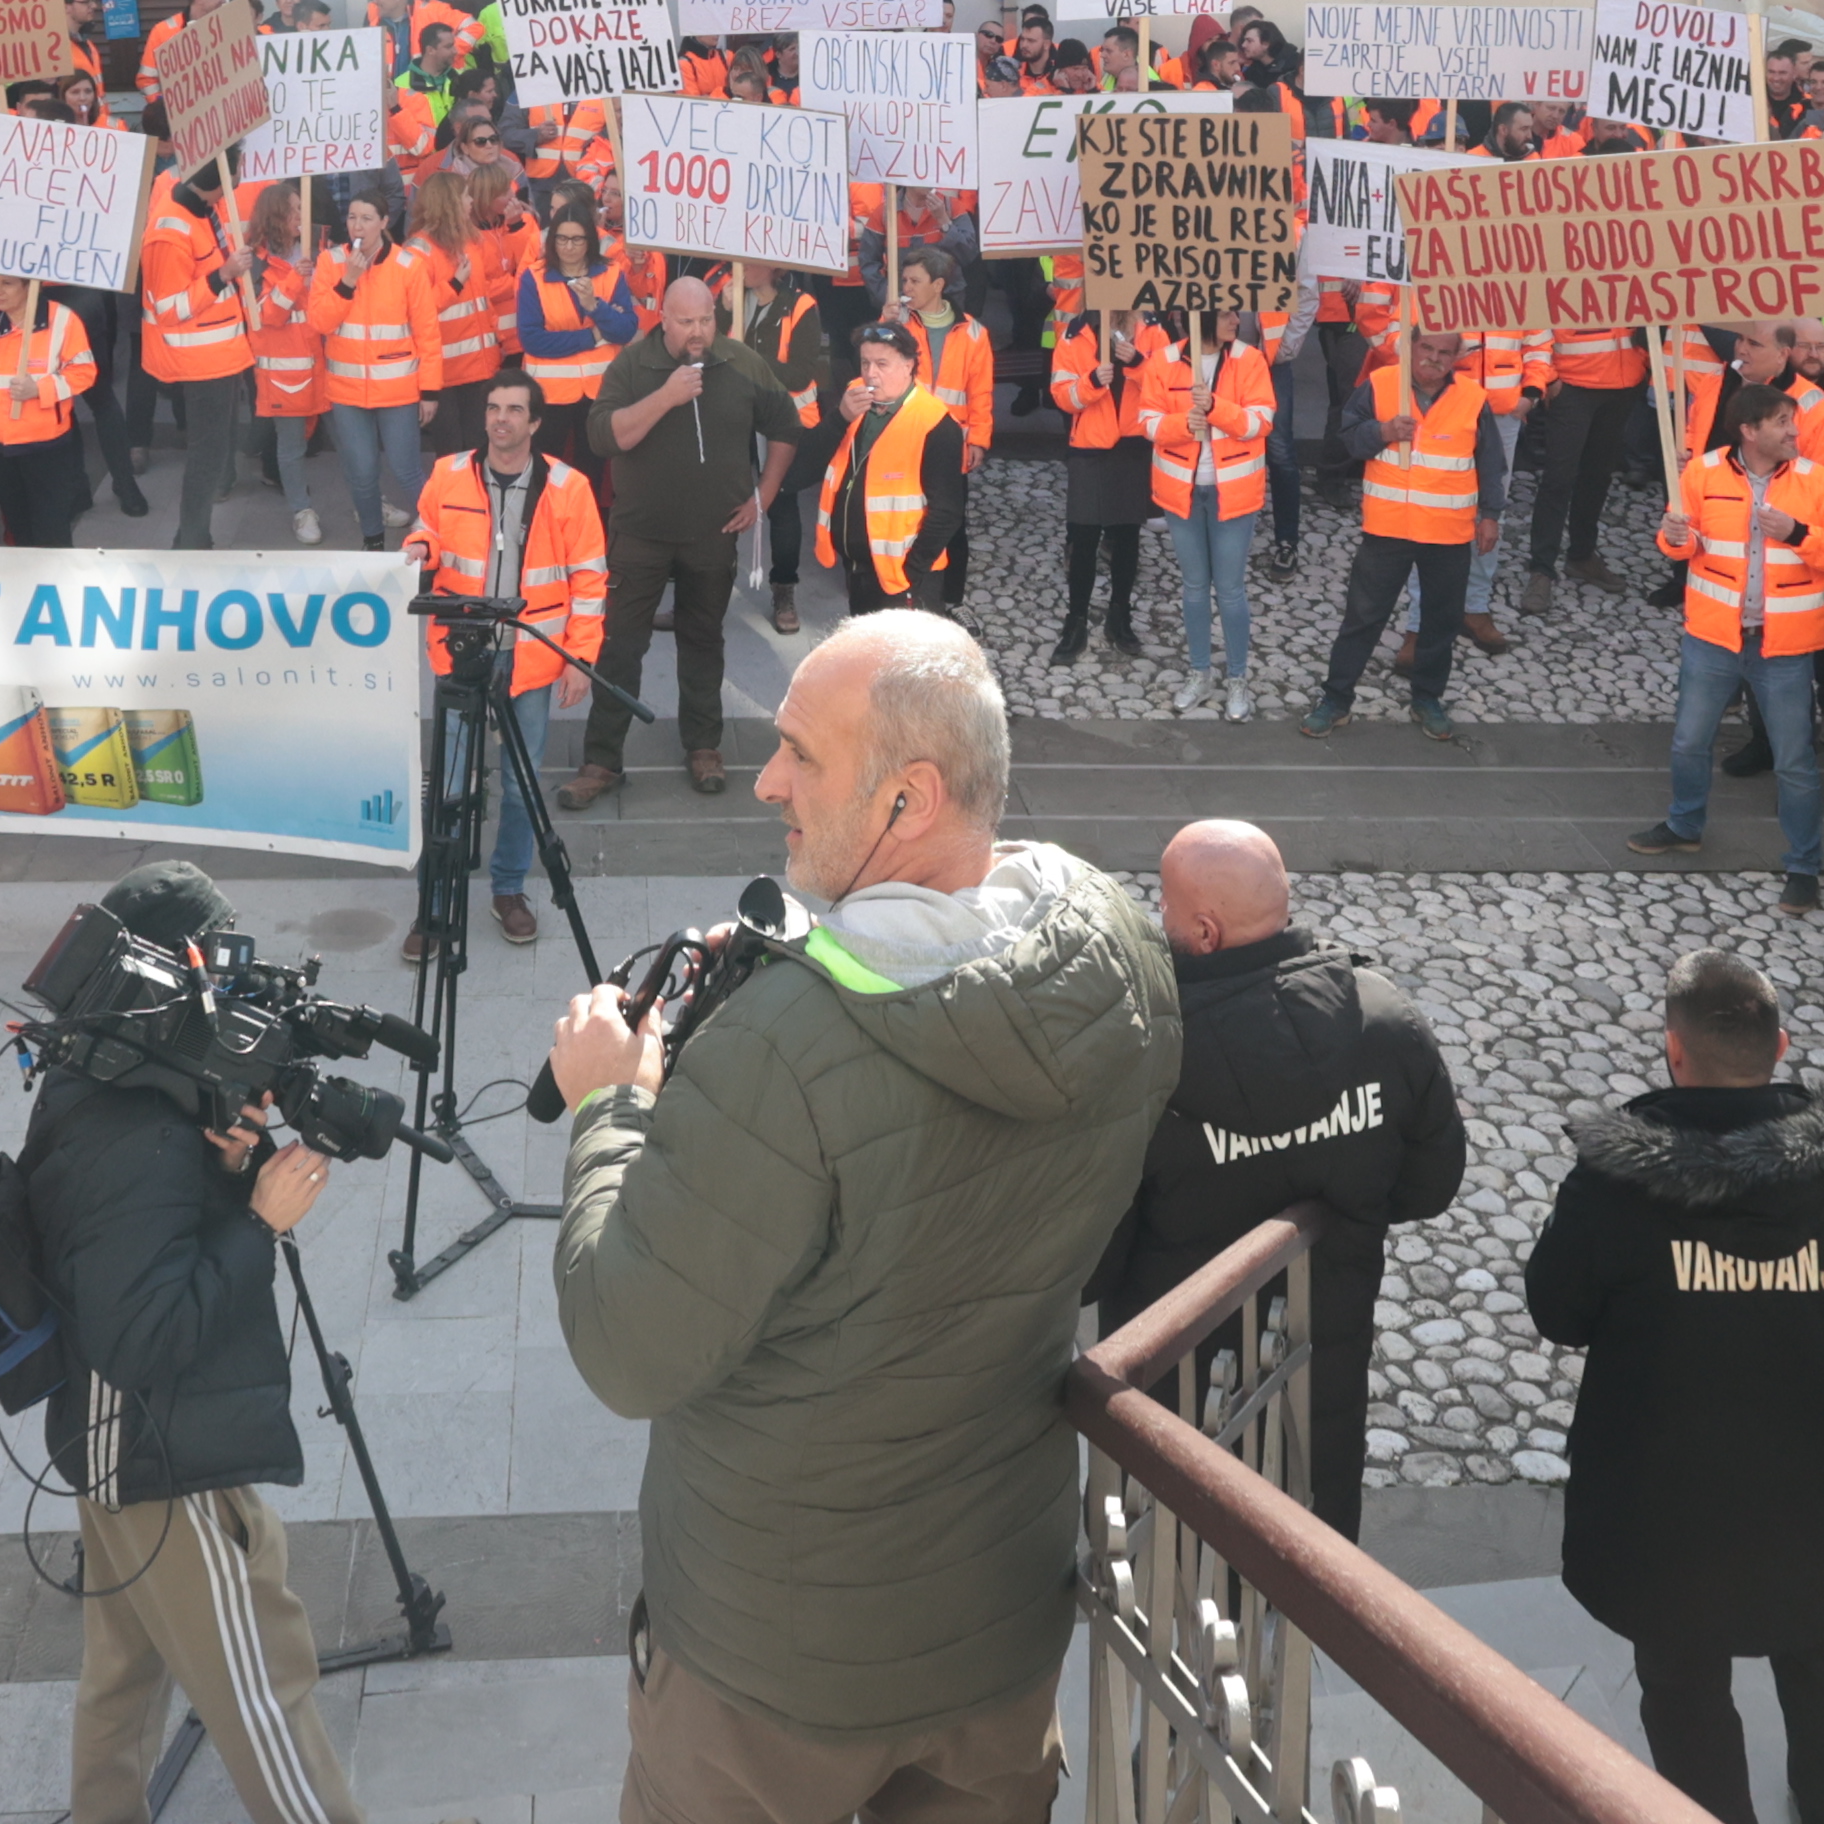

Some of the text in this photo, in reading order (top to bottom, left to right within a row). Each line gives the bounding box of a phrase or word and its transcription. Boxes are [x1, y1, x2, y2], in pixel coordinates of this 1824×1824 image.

[207, 13, 224, 50] SI
[528, 9, 644, 48] DOKAZE
[730, 6, 793, 32] BREZ
[1307, 6, 1584, 51] NOVE MEJNE VREDNOSTI
[1635, 1, 1736, 48] DOVOLJ
[164, 34, 259, 119] POZABIL NA
[262, 35, 360, 77] NIKA
[512, 43, 614, 97] ZA VAŠE
[812, 32, 972, 105] OBČINSKI SVET
[1437, 46, 1490, 77] VSEH
[1595, 34, 1752, 96] NAM JE LAŽNIH
[301, 78, 337, 113] TE
[1352, 69, 1585, 98] CEMENTARN V EU
[1606, 71, 1706, 132] MESIJ
[172, 104, 224, 173] SVOJO
[644, 97, 838, 167] VEČ KOT
[843, 100, 954, 144] VKLOPITE
[1079, 117, 1259, 158] KJE STE BILI
[2, 120, 118, 174] NAROD
[636, 150, 841, 227] 1000 DRUŽIN
[1099, 160, 1293, 205] ZDRAVNIKI
[1398, 167, 1490, 223] VAŠE
[1499, 157, 1664, 217] FLOSKULE
[1673, 153, 1702, 207] O
[34, 204, 112, 253] FUL
[628, 195, 659, 241] BO
[675, 201, 728, 250] BREZ
[1082, 201, 1289, 244] KO JE BIL RES
[1087, 234, 1296, 283] ŠE PRISOTEN
[1405, 226, 1454, 278] ZA
[1460, 222, 1548, 277] LJUDI
[1563, 218, 1655, 273] BODO
[1131, 279, 1267, 312] AZBEST
[14, 582, 392, 651] ANHOVO
[72, 665, 393, 692] www.salonit.si
[102, 773, 117, 788] R
